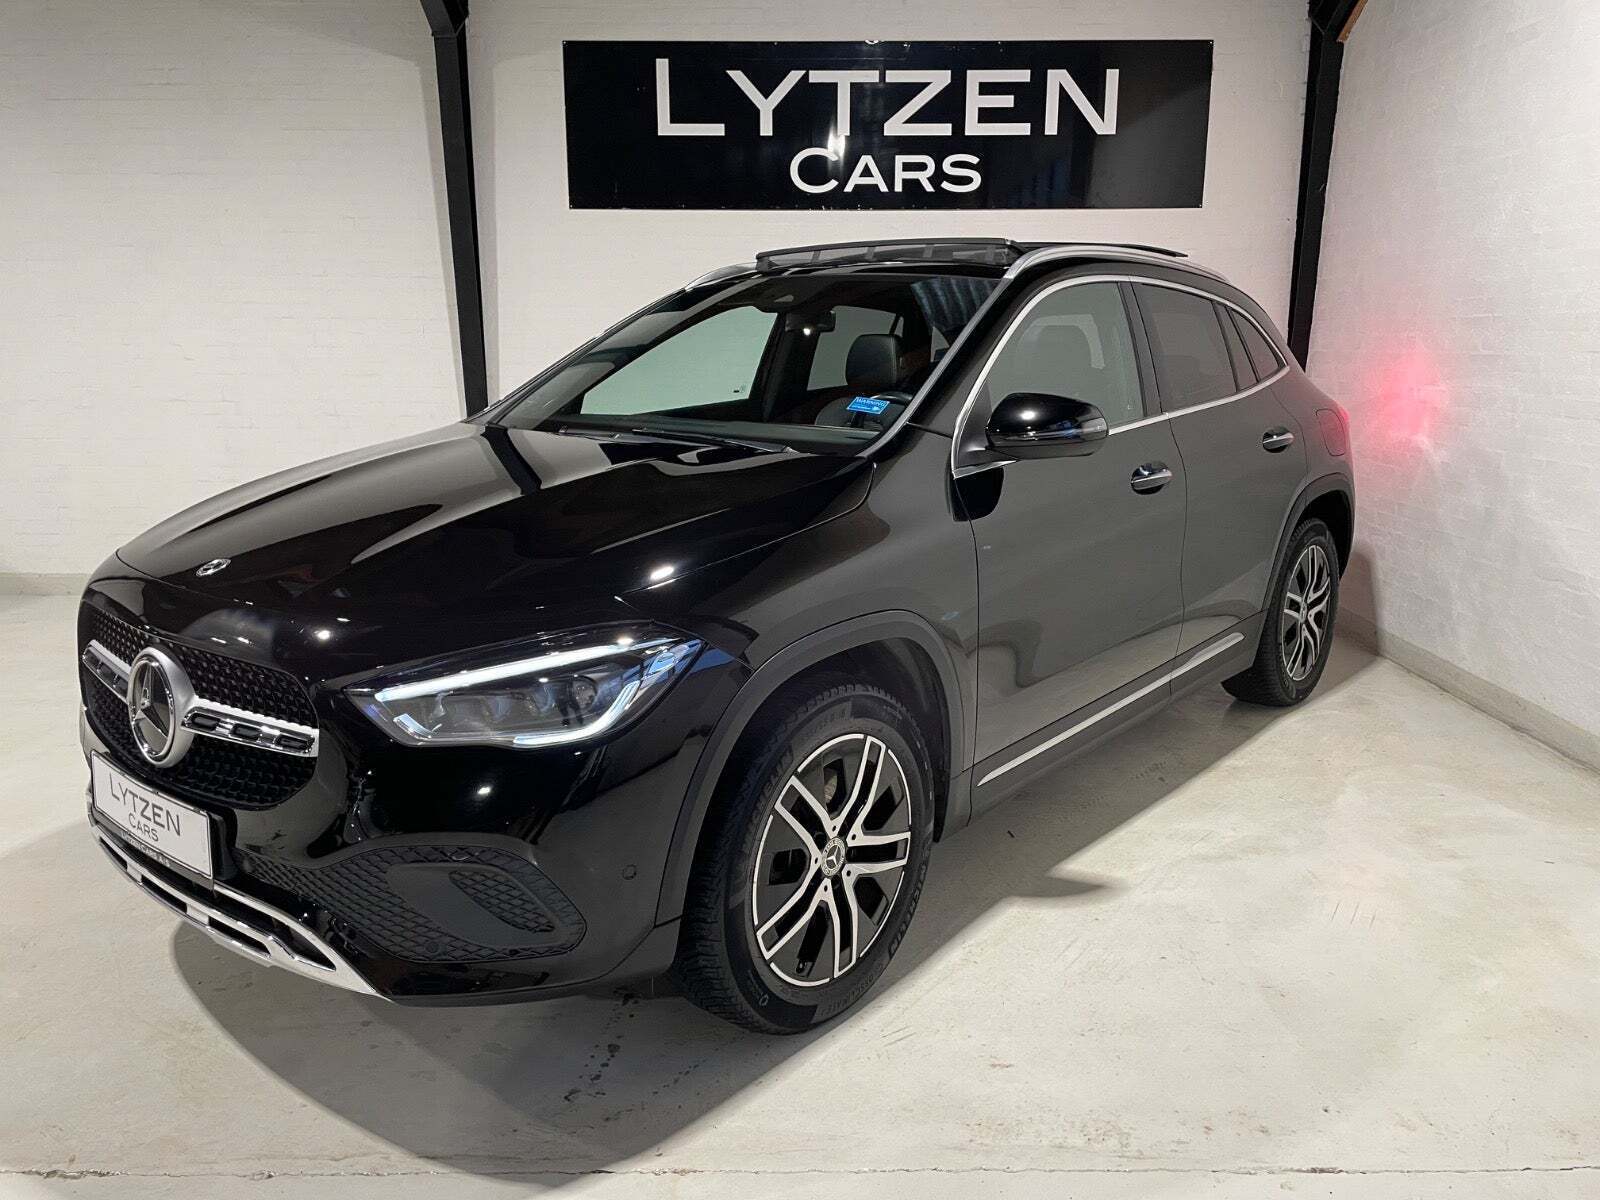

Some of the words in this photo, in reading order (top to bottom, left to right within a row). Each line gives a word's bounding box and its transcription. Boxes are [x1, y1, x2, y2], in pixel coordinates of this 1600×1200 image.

[655, 57, 1120, 137] LYTZEN
[109, 772, 181, 837] LYTZEN
[128, 812, 159, 842] CARS
